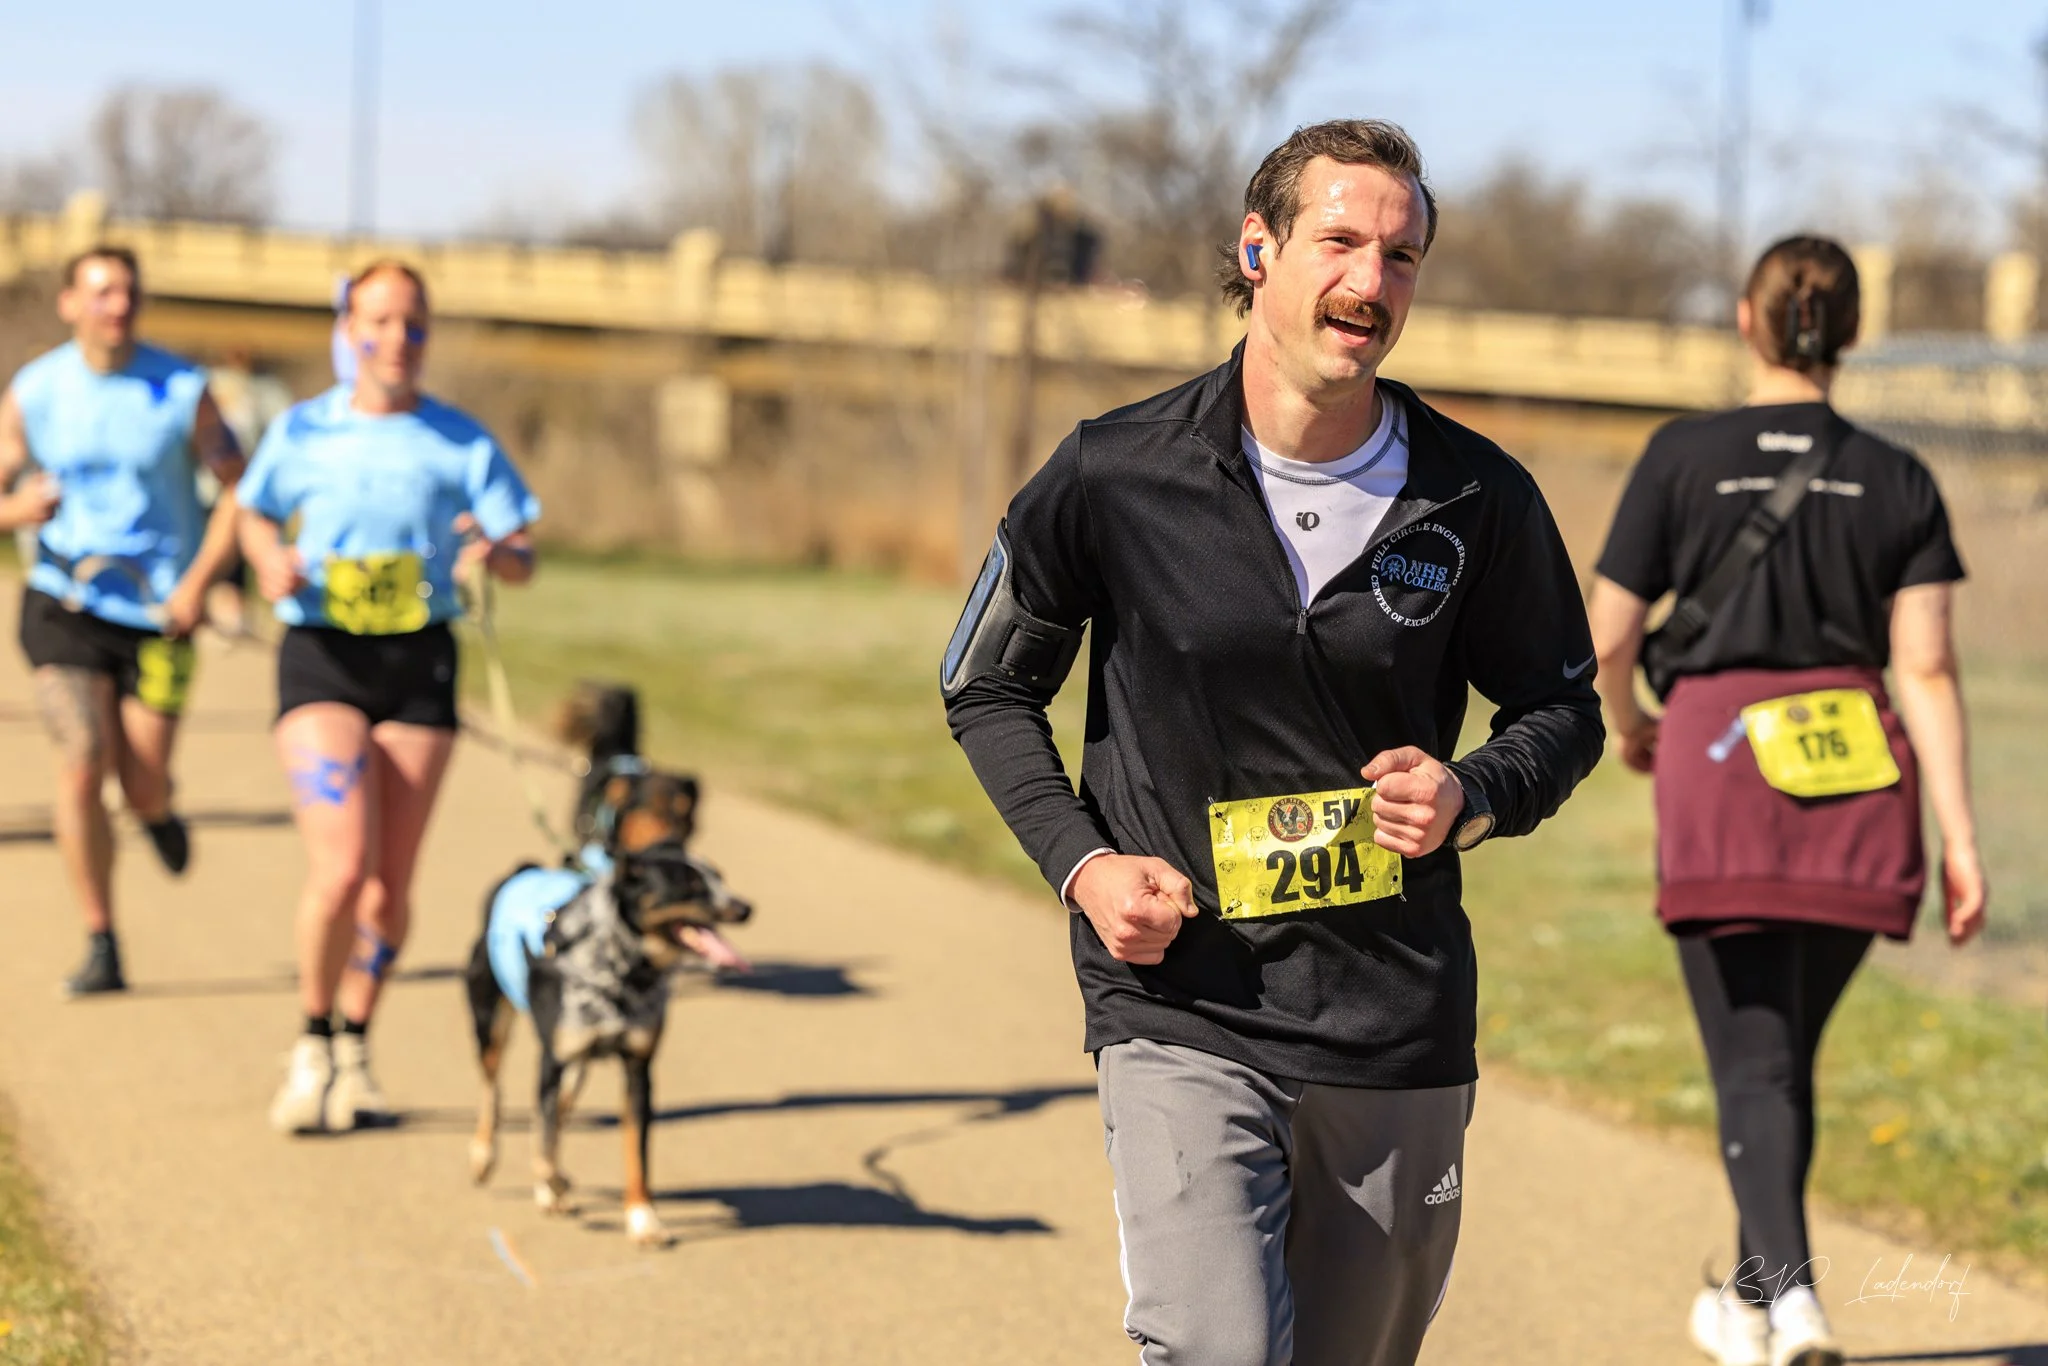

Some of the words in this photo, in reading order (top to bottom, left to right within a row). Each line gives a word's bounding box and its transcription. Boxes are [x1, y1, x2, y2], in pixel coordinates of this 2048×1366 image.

[1371, 543, 1390, 572] FULL
[1389, 522, 1431, 543] CIRCLE
[1410, 559, 1448, 582] NHS
[1370, 574, 1392, 615] CENTER
[1391, 612, 1405, 623] OF
[1797, 729, 1848, 761] 176
[1323, 797, 1361, 831] 5K
[1266, 840, 1365, 904] 294
[1424, 1186, 1461, 1205] adidas
